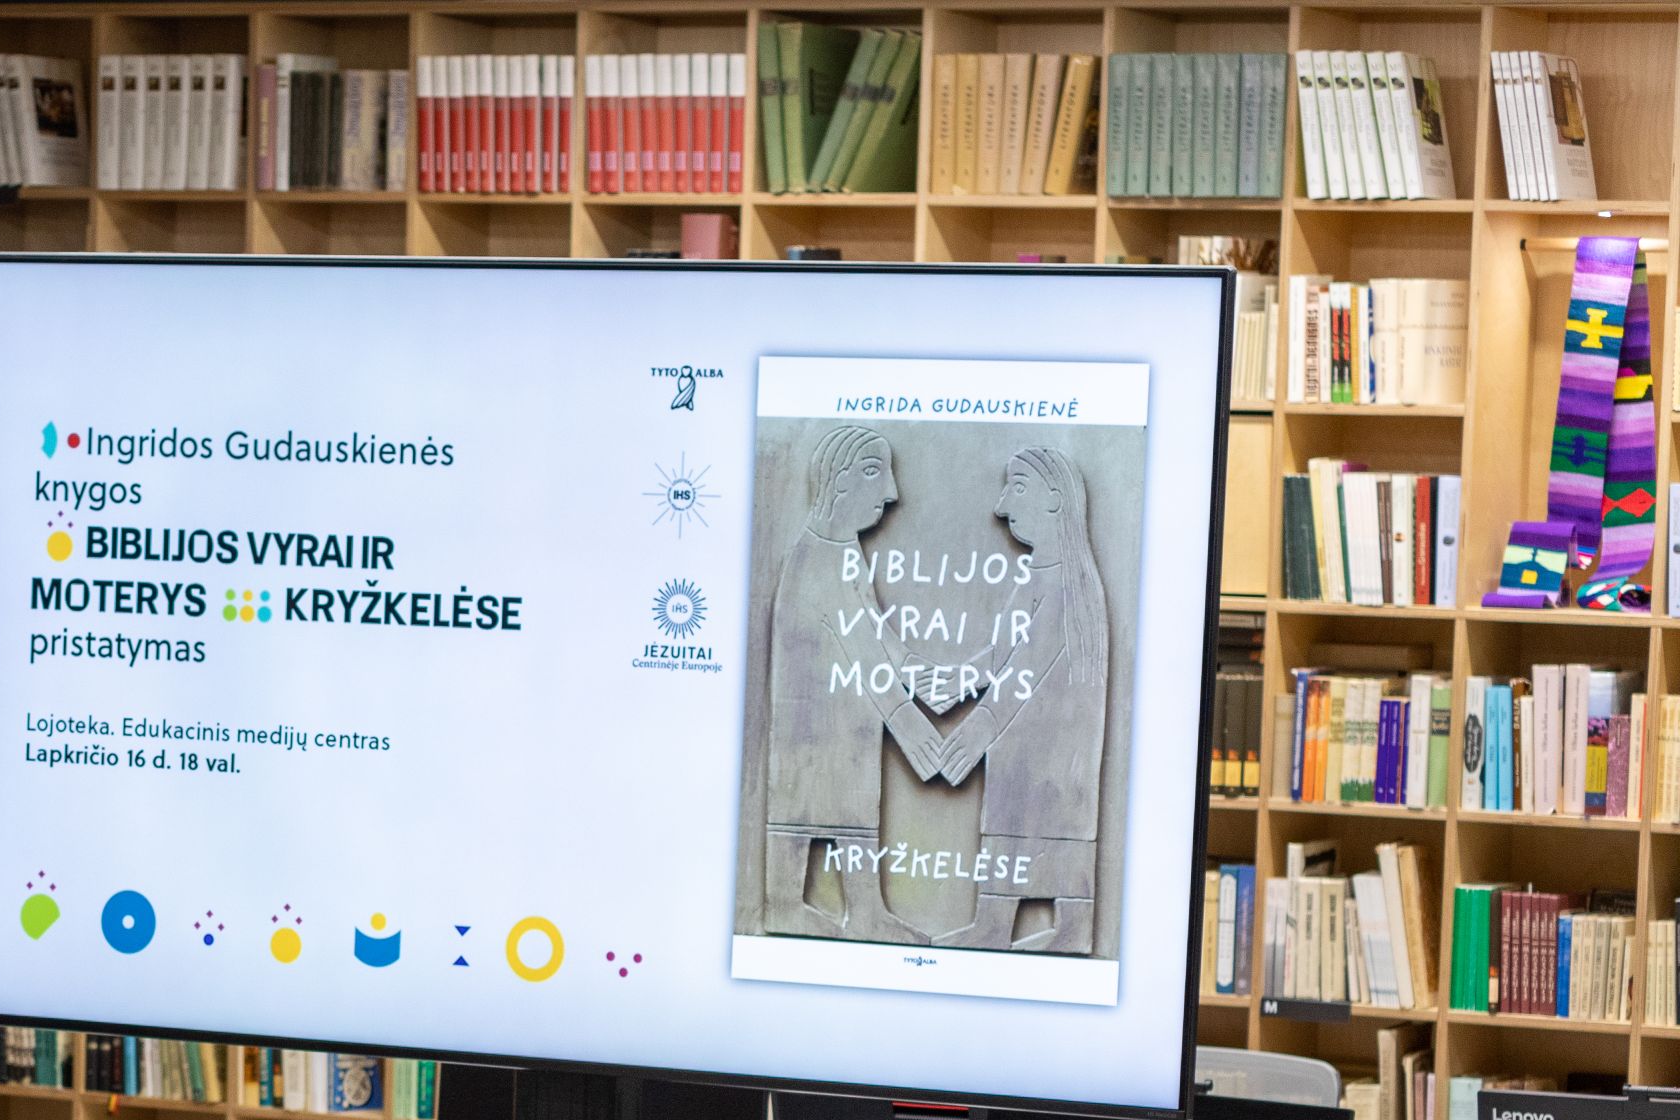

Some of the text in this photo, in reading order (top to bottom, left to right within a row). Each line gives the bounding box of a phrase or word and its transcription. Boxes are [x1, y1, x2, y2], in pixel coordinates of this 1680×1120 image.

[651, 367, 724, 378] TYTO ALBA
[836, 397, 1079, 418] INGRIDA GUDAUSKIENĖ
[87, 427, 454, 466] Ingridos Gudauskienės
[35, 471, 142, 511] knygos
[673, 490, 691, 501] IHS
[86, 525, 395, 570] BIBLIJOS VYRAI IR
[841, 547, 1033, 587] BIBLIJOS
[30, 577, 523, 631] MOTERYS KRYŽKELĖSE
[837, 605, 1031, 647] VYRAI IR
[30, 628, 206, 667] pristatymas
[632, 659, 723, 674] Centrinėje Europoje
[643, 641, 712, 661] JĖZUITAI
[829, 661, 1035, 703] MOTERYS
[26, 712, 390, 752] Lojoteka. Edukacinis medijų centras
[25, 742, 241, 774] Lapkričio 16 d. 18 val.
[824, 842, 1031, 884] KRYŽKELĖSE
[1264, 1000, 1278, 1015] M
